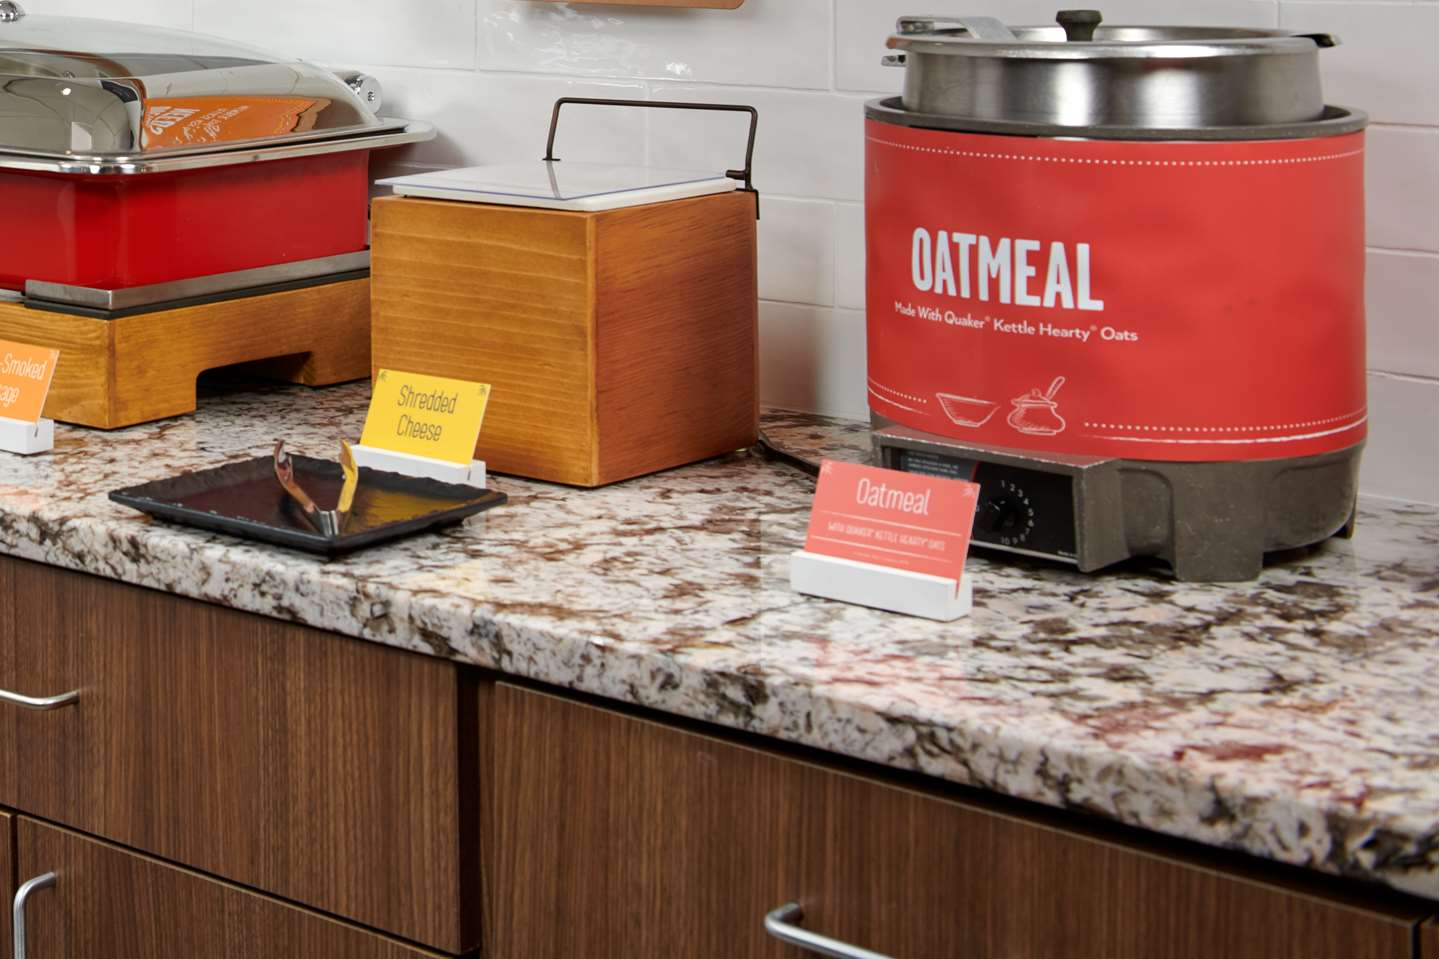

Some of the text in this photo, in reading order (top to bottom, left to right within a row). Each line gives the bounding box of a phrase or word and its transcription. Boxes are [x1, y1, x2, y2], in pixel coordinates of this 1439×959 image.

[911, 226, 1105, 311] OATMEAL
[894, 300, 916, 318] Made
[917, 306, 942, 323] With
[993, 318, 1036, 336] Kettle
[1100, 326, 1139, 342] Oats
[397, 384, 458, 414] Shredded
[396, 414, 442, 441] Cheese
[856, 477, 931, 516] Oatmeal
